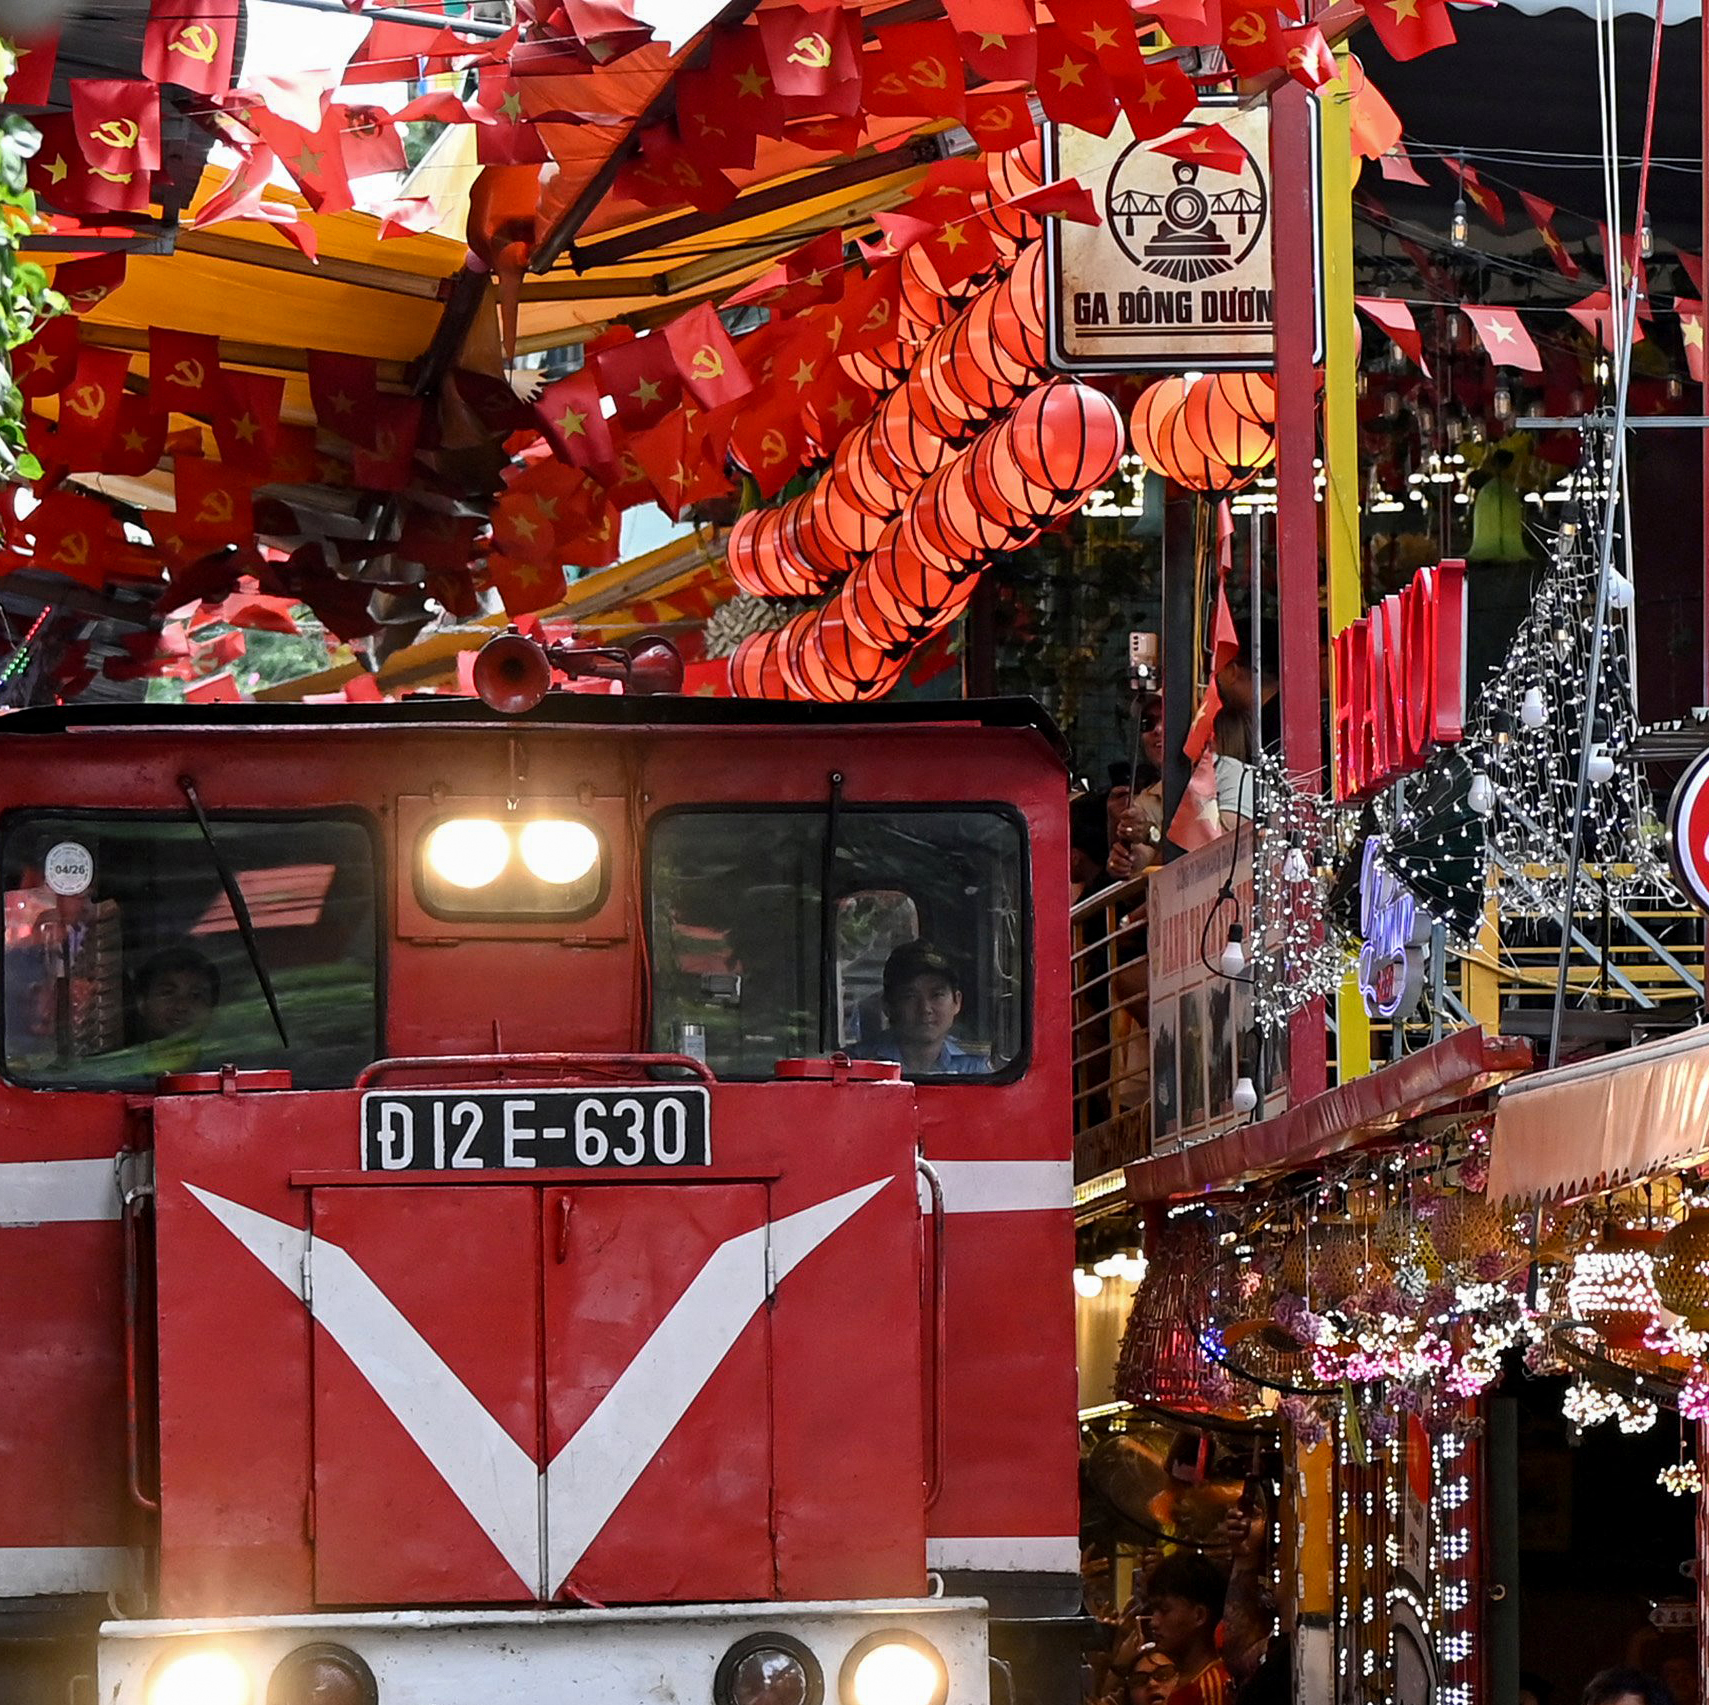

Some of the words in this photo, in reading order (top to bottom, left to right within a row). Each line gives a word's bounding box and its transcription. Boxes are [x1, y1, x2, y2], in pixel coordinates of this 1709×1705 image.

[1074, 292, 1110, 325] GA
[1117, 285, 1193, 325] ĐÔNG
[1201, 286, 1273, 324] DƯƠN
